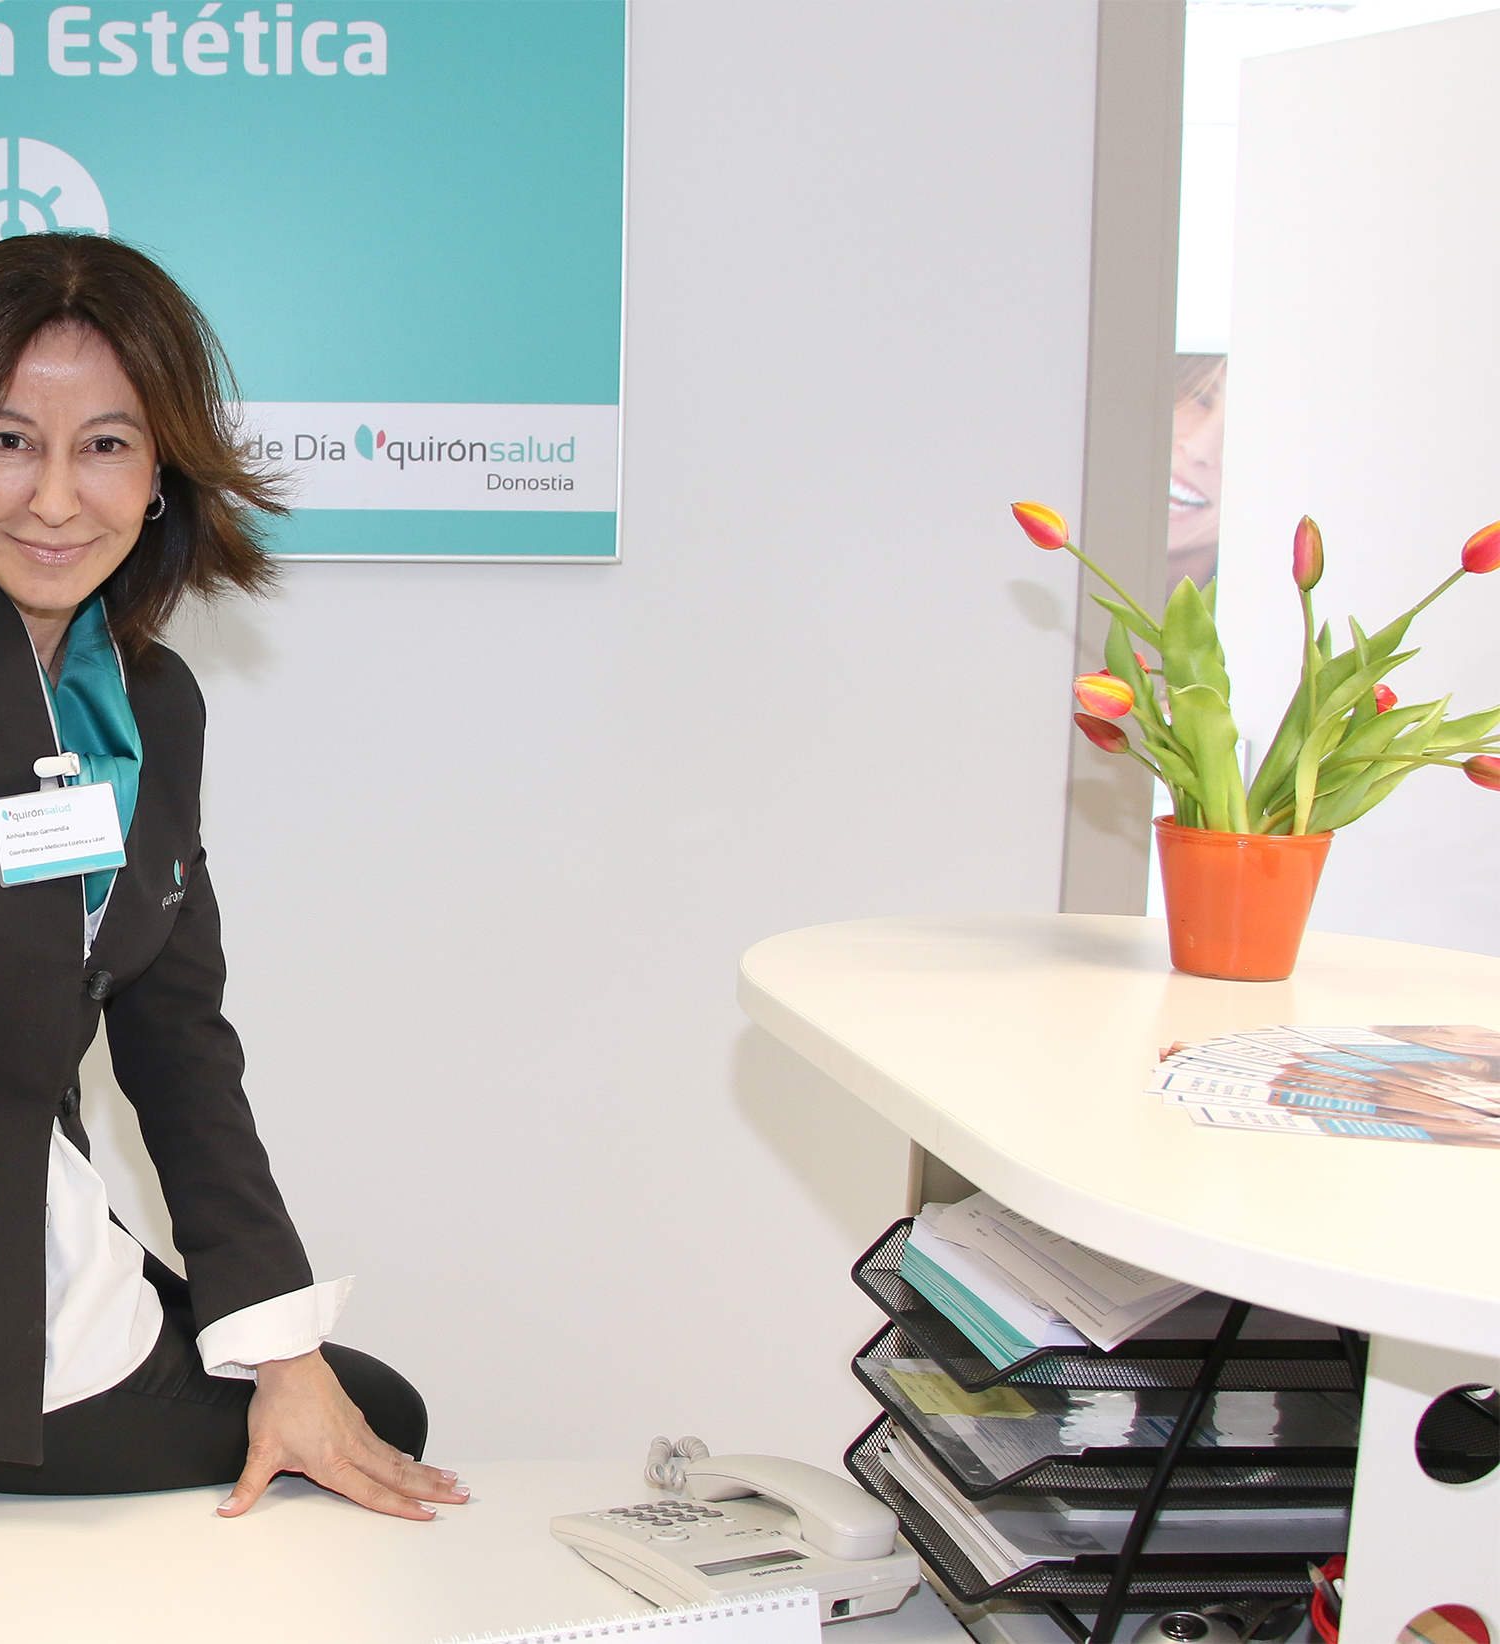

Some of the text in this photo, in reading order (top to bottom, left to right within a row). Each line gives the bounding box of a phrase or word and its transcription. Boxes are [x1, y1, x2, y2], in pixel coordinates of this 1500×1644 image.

[47, 2, 389, 77] Estética
[249, 433, 575, 470] de Día quirónsalud
[487, 473, 574, 491] Donostia
[5, 825, 70, 840] Ainhoa Rojo Garmendia
[749, 1564, 804, 1578] Panasonic
